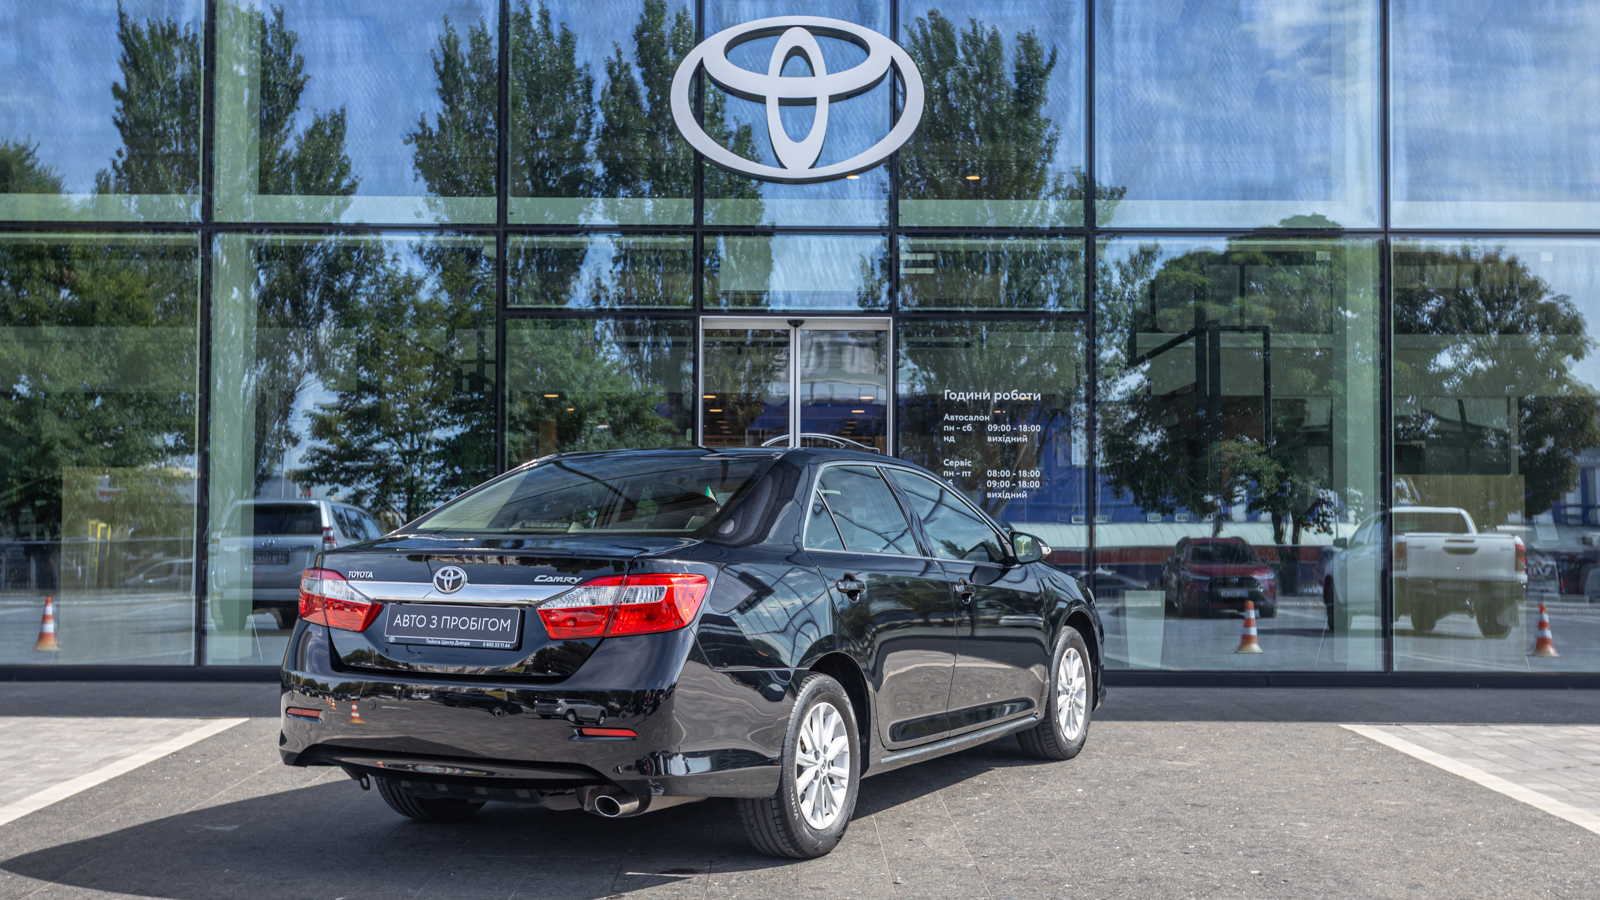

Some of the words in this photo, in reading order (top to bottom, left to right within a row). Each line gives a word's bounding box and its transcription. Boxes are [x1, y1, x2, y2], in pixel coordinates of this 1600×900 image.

[944, 389, 991, 402] Години
[994, 389, 1042, 403] роботи
[943, 413, 990, 422] Автосалон
[962, 424, 973, 432] сб
[987, 424, 1011, 432] 09:00
[1018, 424, 1041, 432] 18:00
[987, 434, 1028, 443] вихідний
[943, 458, 972, 467] Сервіс
[986, 469, 1011, 477] 08:00
[1018, 469, 1041, 477] 18:00
[986, 480, 1011, 488] 09:00
[1018, 480, 1040, 488] 18:00
[986, 490, 1028, 499] вихідний
[348, 570, 374, 579] TOYOTA
[392, 614, 427, 628] АВТО
[440, 616, 511, 632] ПРОБІГОМ
